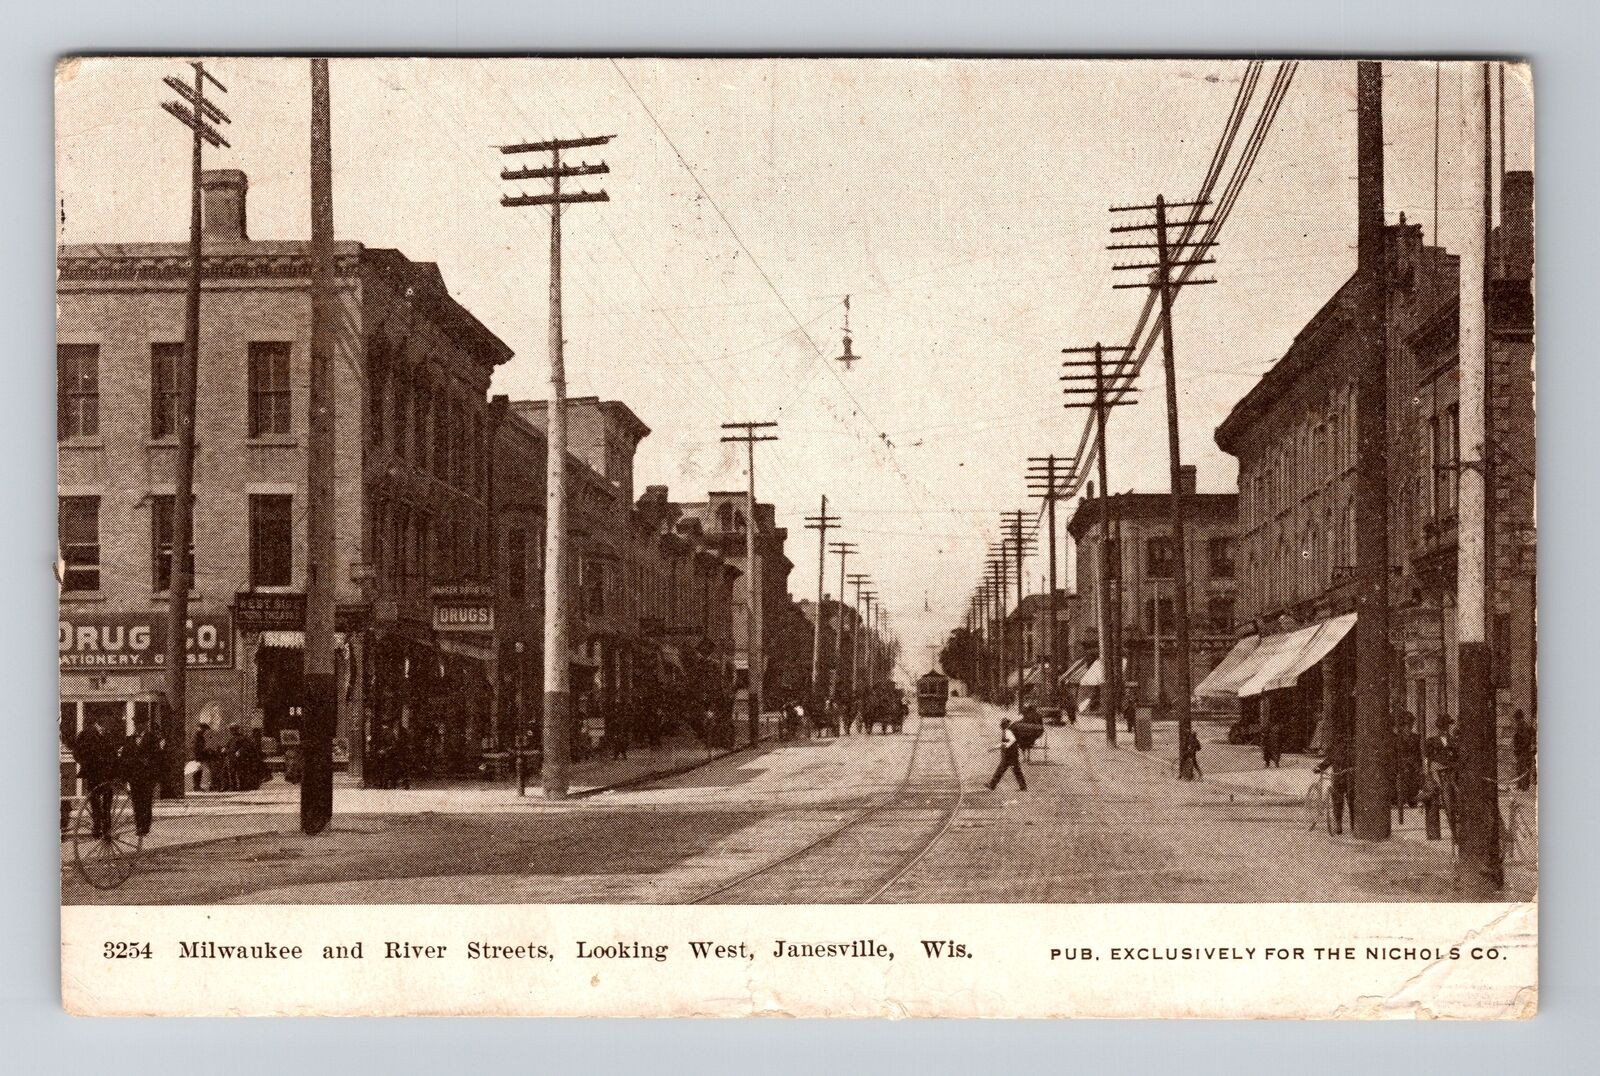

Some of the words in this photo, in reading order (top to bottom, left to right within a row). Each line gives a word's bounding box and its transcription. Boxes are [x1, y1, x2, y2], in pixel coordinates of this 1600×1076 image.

[440, 607, 488, 622] DRUGS
[103, 941, 153, 959] 3254
[179, 941, 303, 959] Milwaukee
[322, 941, 364, 959] and
[384, 941, 447, 959] River
[467, 941, 554, 962] Streets,
[576, 941, 669, 962] Looking
[688, 941, 754, 961] West,
[773, 939, 895, 961] Janesville,
[920, 940, 973, 959] Wis.
[1050, 948, 1099, 961] PUB.
[1111, 947, 1256, 961] EXCLUSIVELY
[1265, 947, 1305, 960] FOR
[1313, 947, 1356, 961] THE
[1366, 947, 1461, 961] NICHOLS
[1470, 947, 1507, 961] CO.
